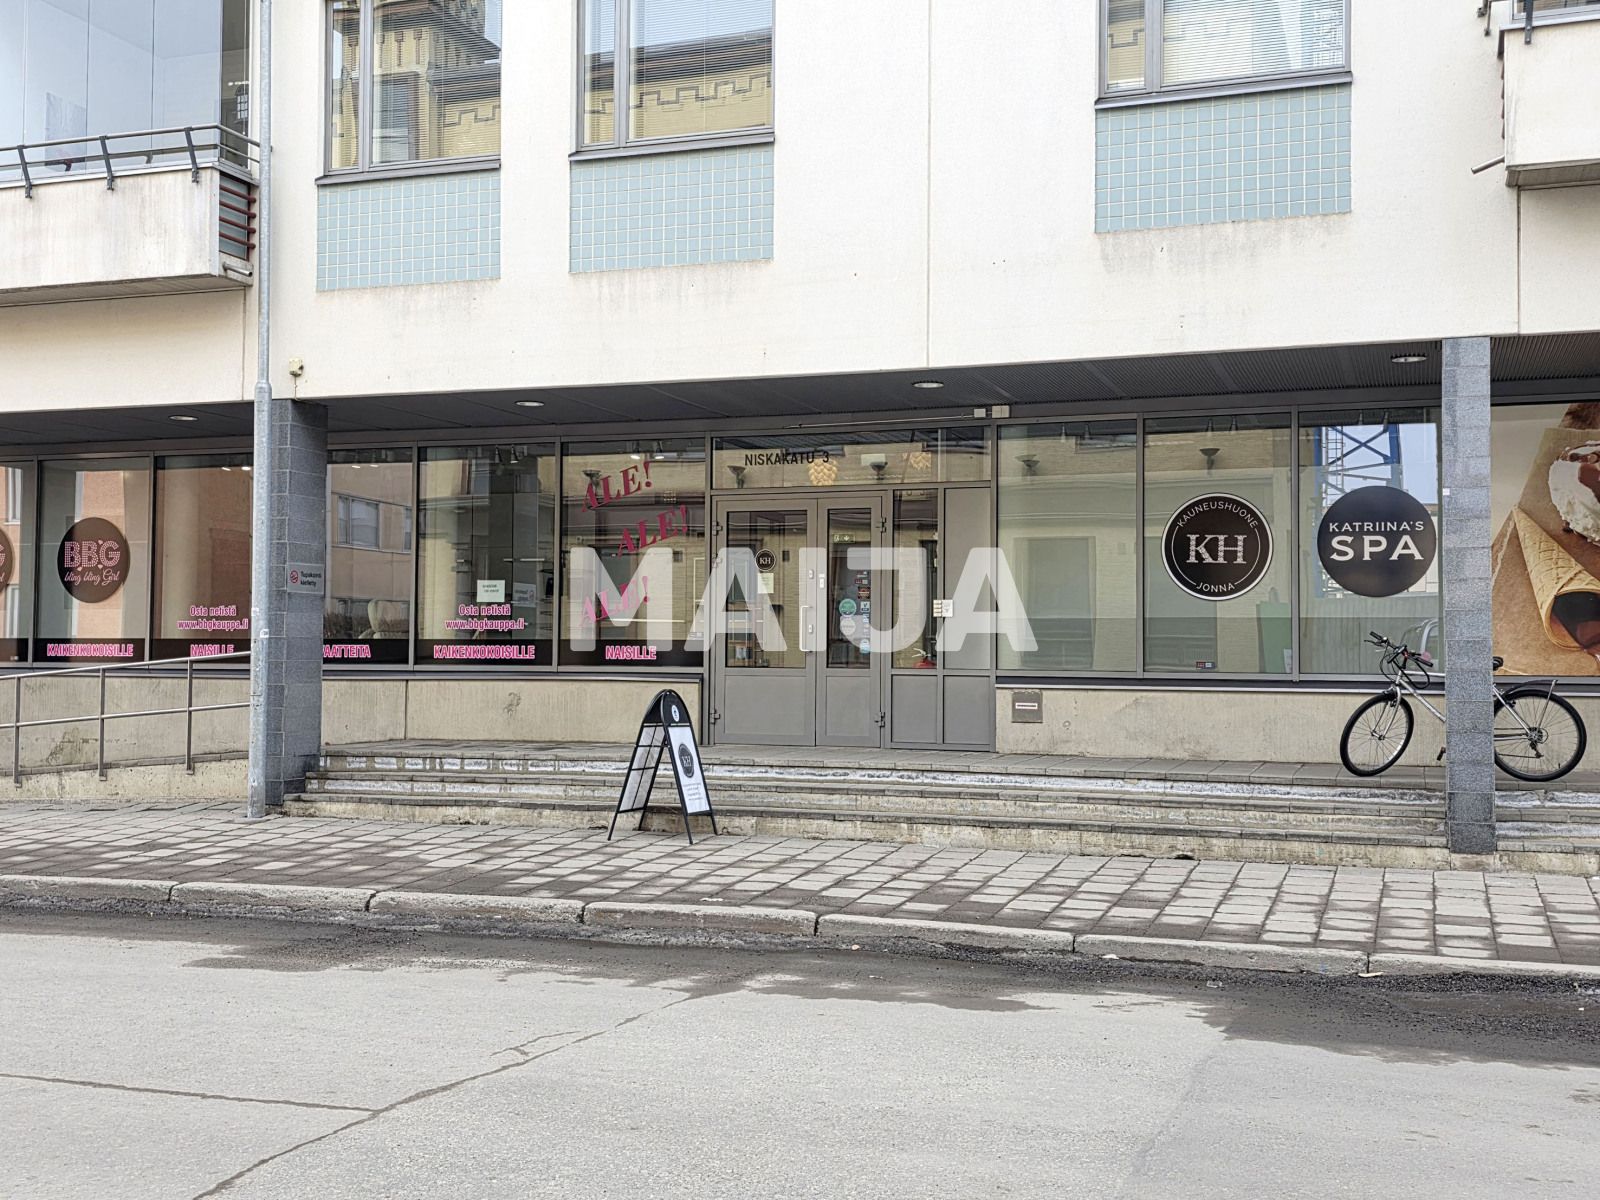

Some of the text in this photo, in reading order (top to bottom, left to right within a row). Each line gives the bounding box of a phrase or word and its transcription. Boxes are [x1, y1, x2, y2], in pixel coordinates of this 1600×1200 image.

[744, 450, 830, 467] NISKAKATU 3
[582, 461, 653, 513] ALE!
[1176, 501, 1259, 528] KAUNEUSHUONE
[617, 505, 689, 557] ALE!
[1329, 521, 1425, 532] KATRIINA'S
[64, 540, 121, 567] BBG
[1186, 534, 1248, 564] KH
[1330, 535, 1425, 562] SPA
[1197, 582, 1235, 593] JONNA
[581, 576, 649, 627] ALE!
[189, 605, 237, 616] Osta netistä
[459, 604, 511, 616] Osta netistä
[177, 619, 249, 631] www.bbgkauppa.fi
[445, 618, 525, 631] www.bbgkauppa.fi
[46, 644, 134, 657] KAIKENKOKOISILLE
[323, 644, 371, 658] AATTEITA
[434, 645, 535, 660] KAIKENKOKOISILLE
[605, 645, 657, 660] NAISILLE
